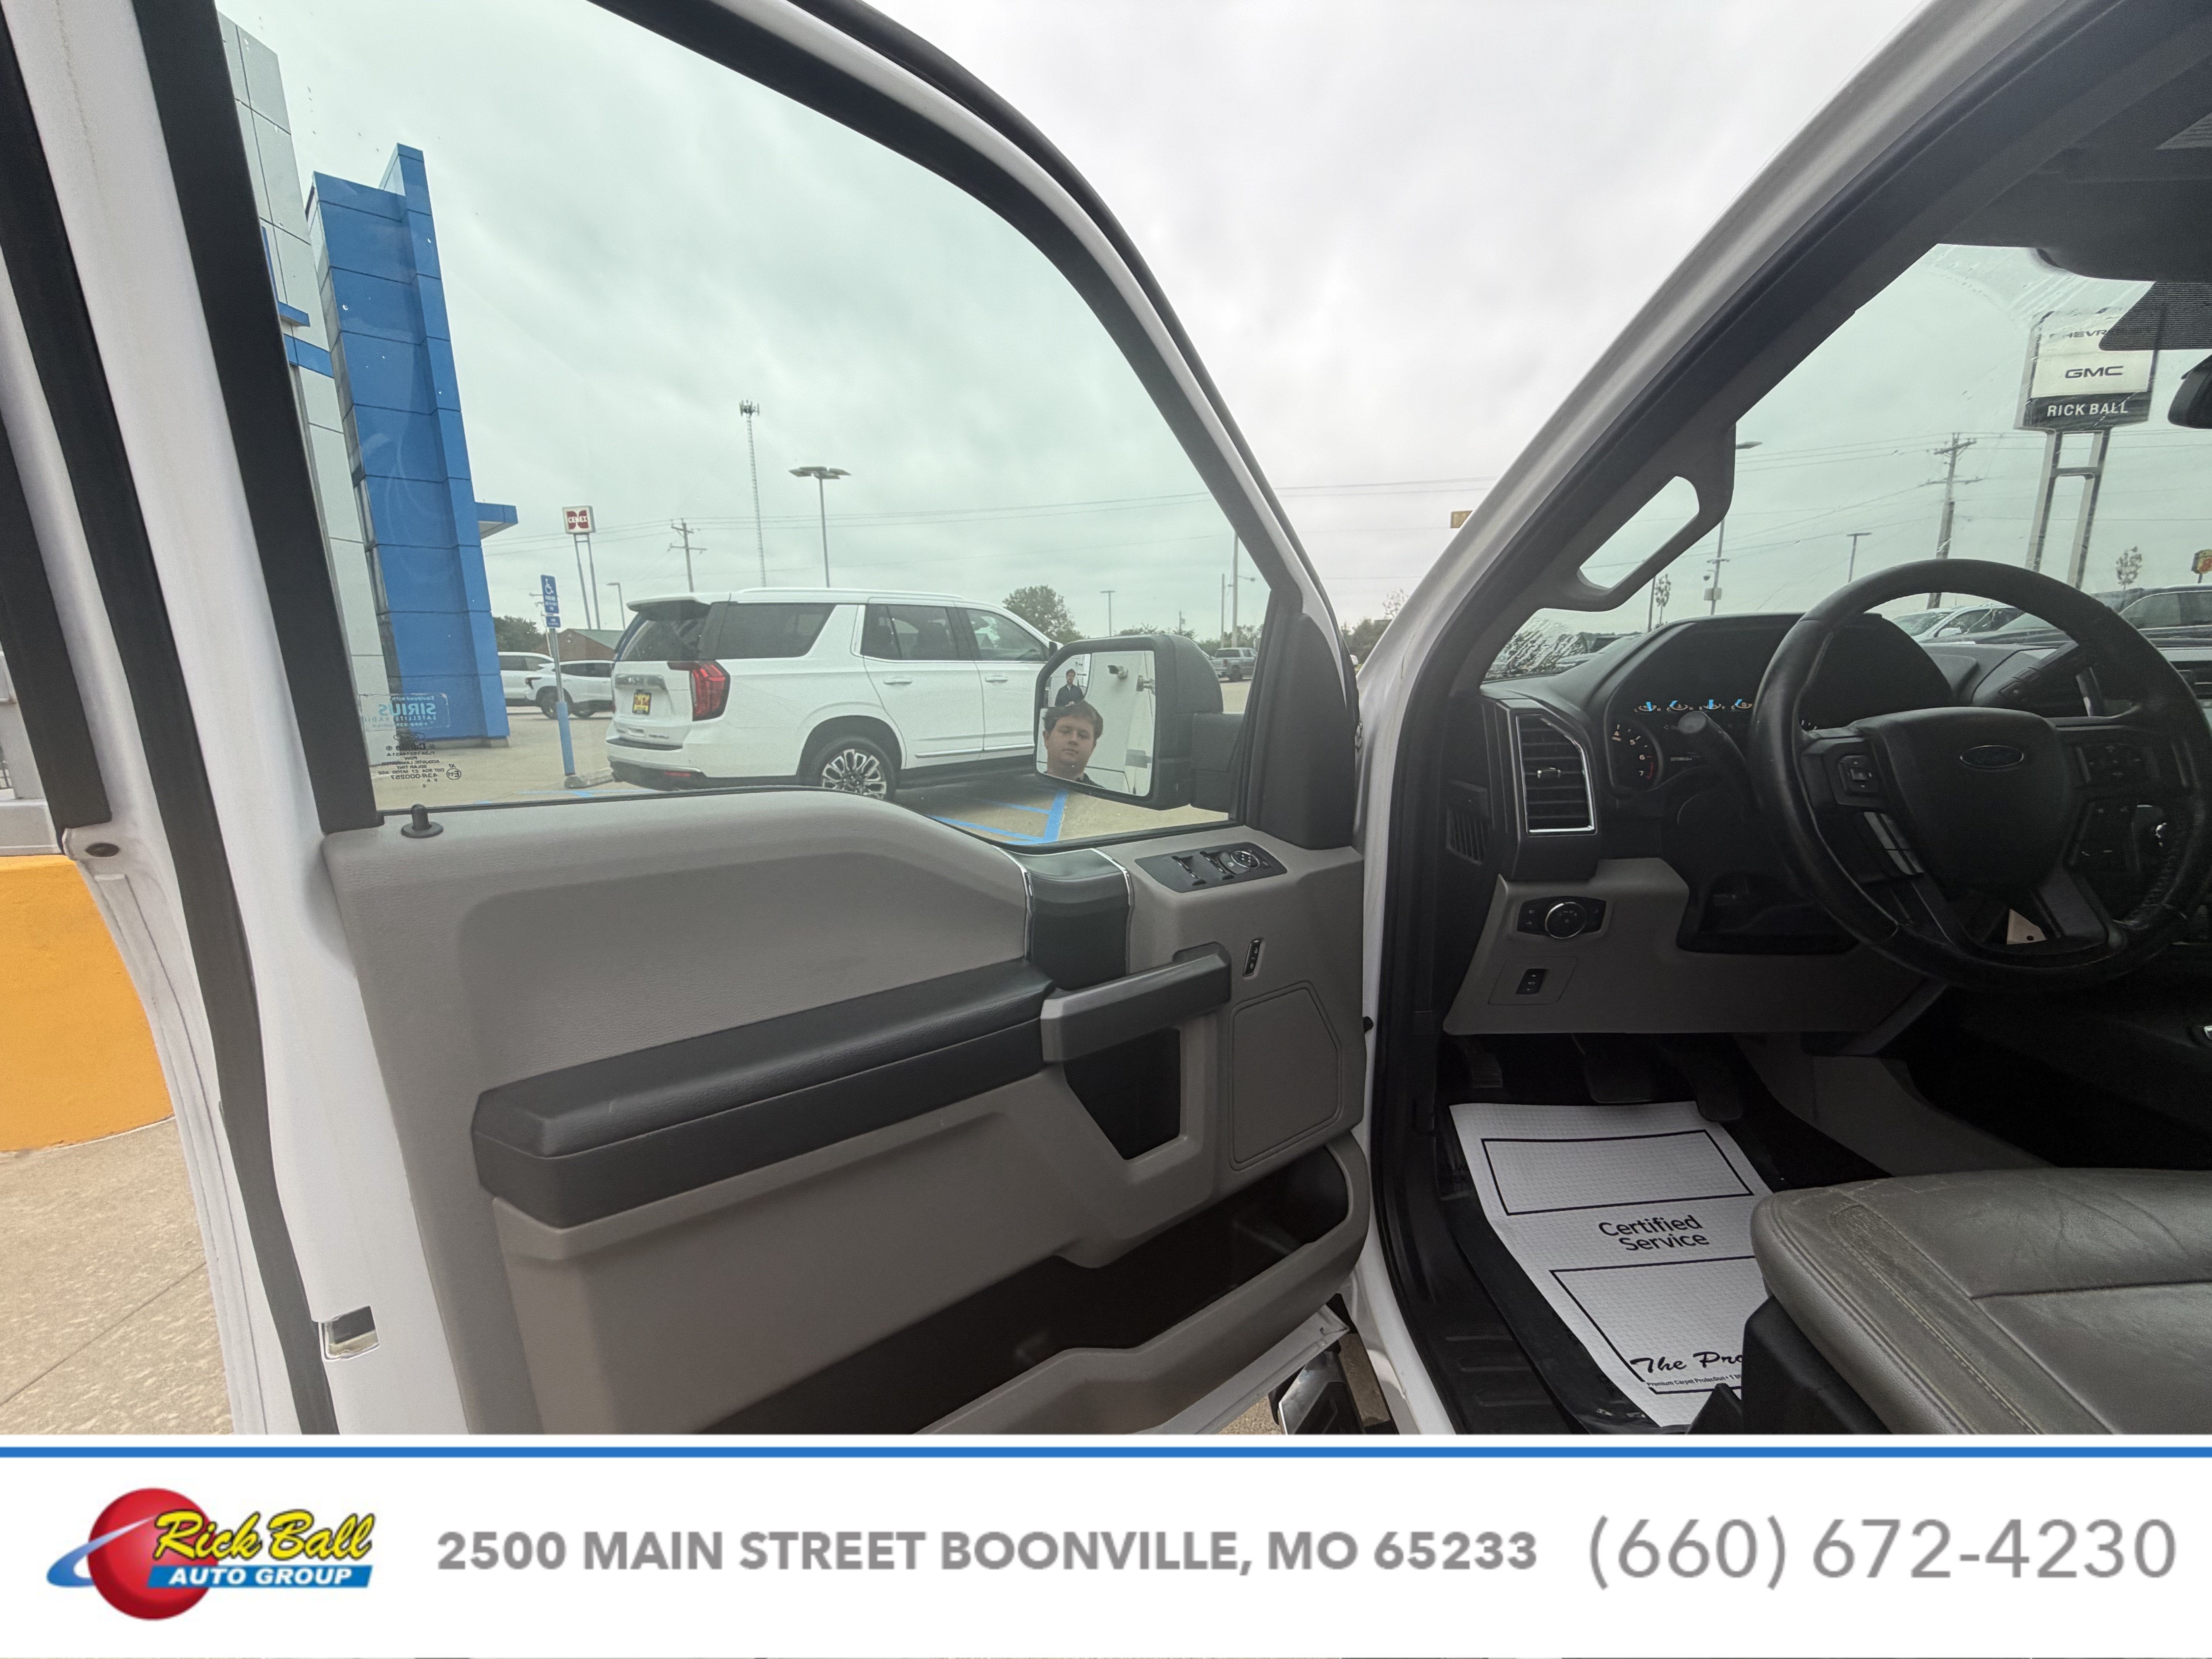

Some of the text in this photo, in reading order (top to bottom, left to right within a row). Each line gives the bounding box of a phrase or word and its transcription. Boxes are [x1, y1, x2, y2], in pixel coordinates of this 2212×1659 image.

[2049, 329, 2108, 338] HEVR
[2065, 366, 2124, 378] GMC
[2047, 402, 2128, 417] RICK BALL
[1599, 1214, 1704, 1236] Certified
[1619, 1233, 1710, 1251] Service
[1630, 1357, 1687, 1373] The
